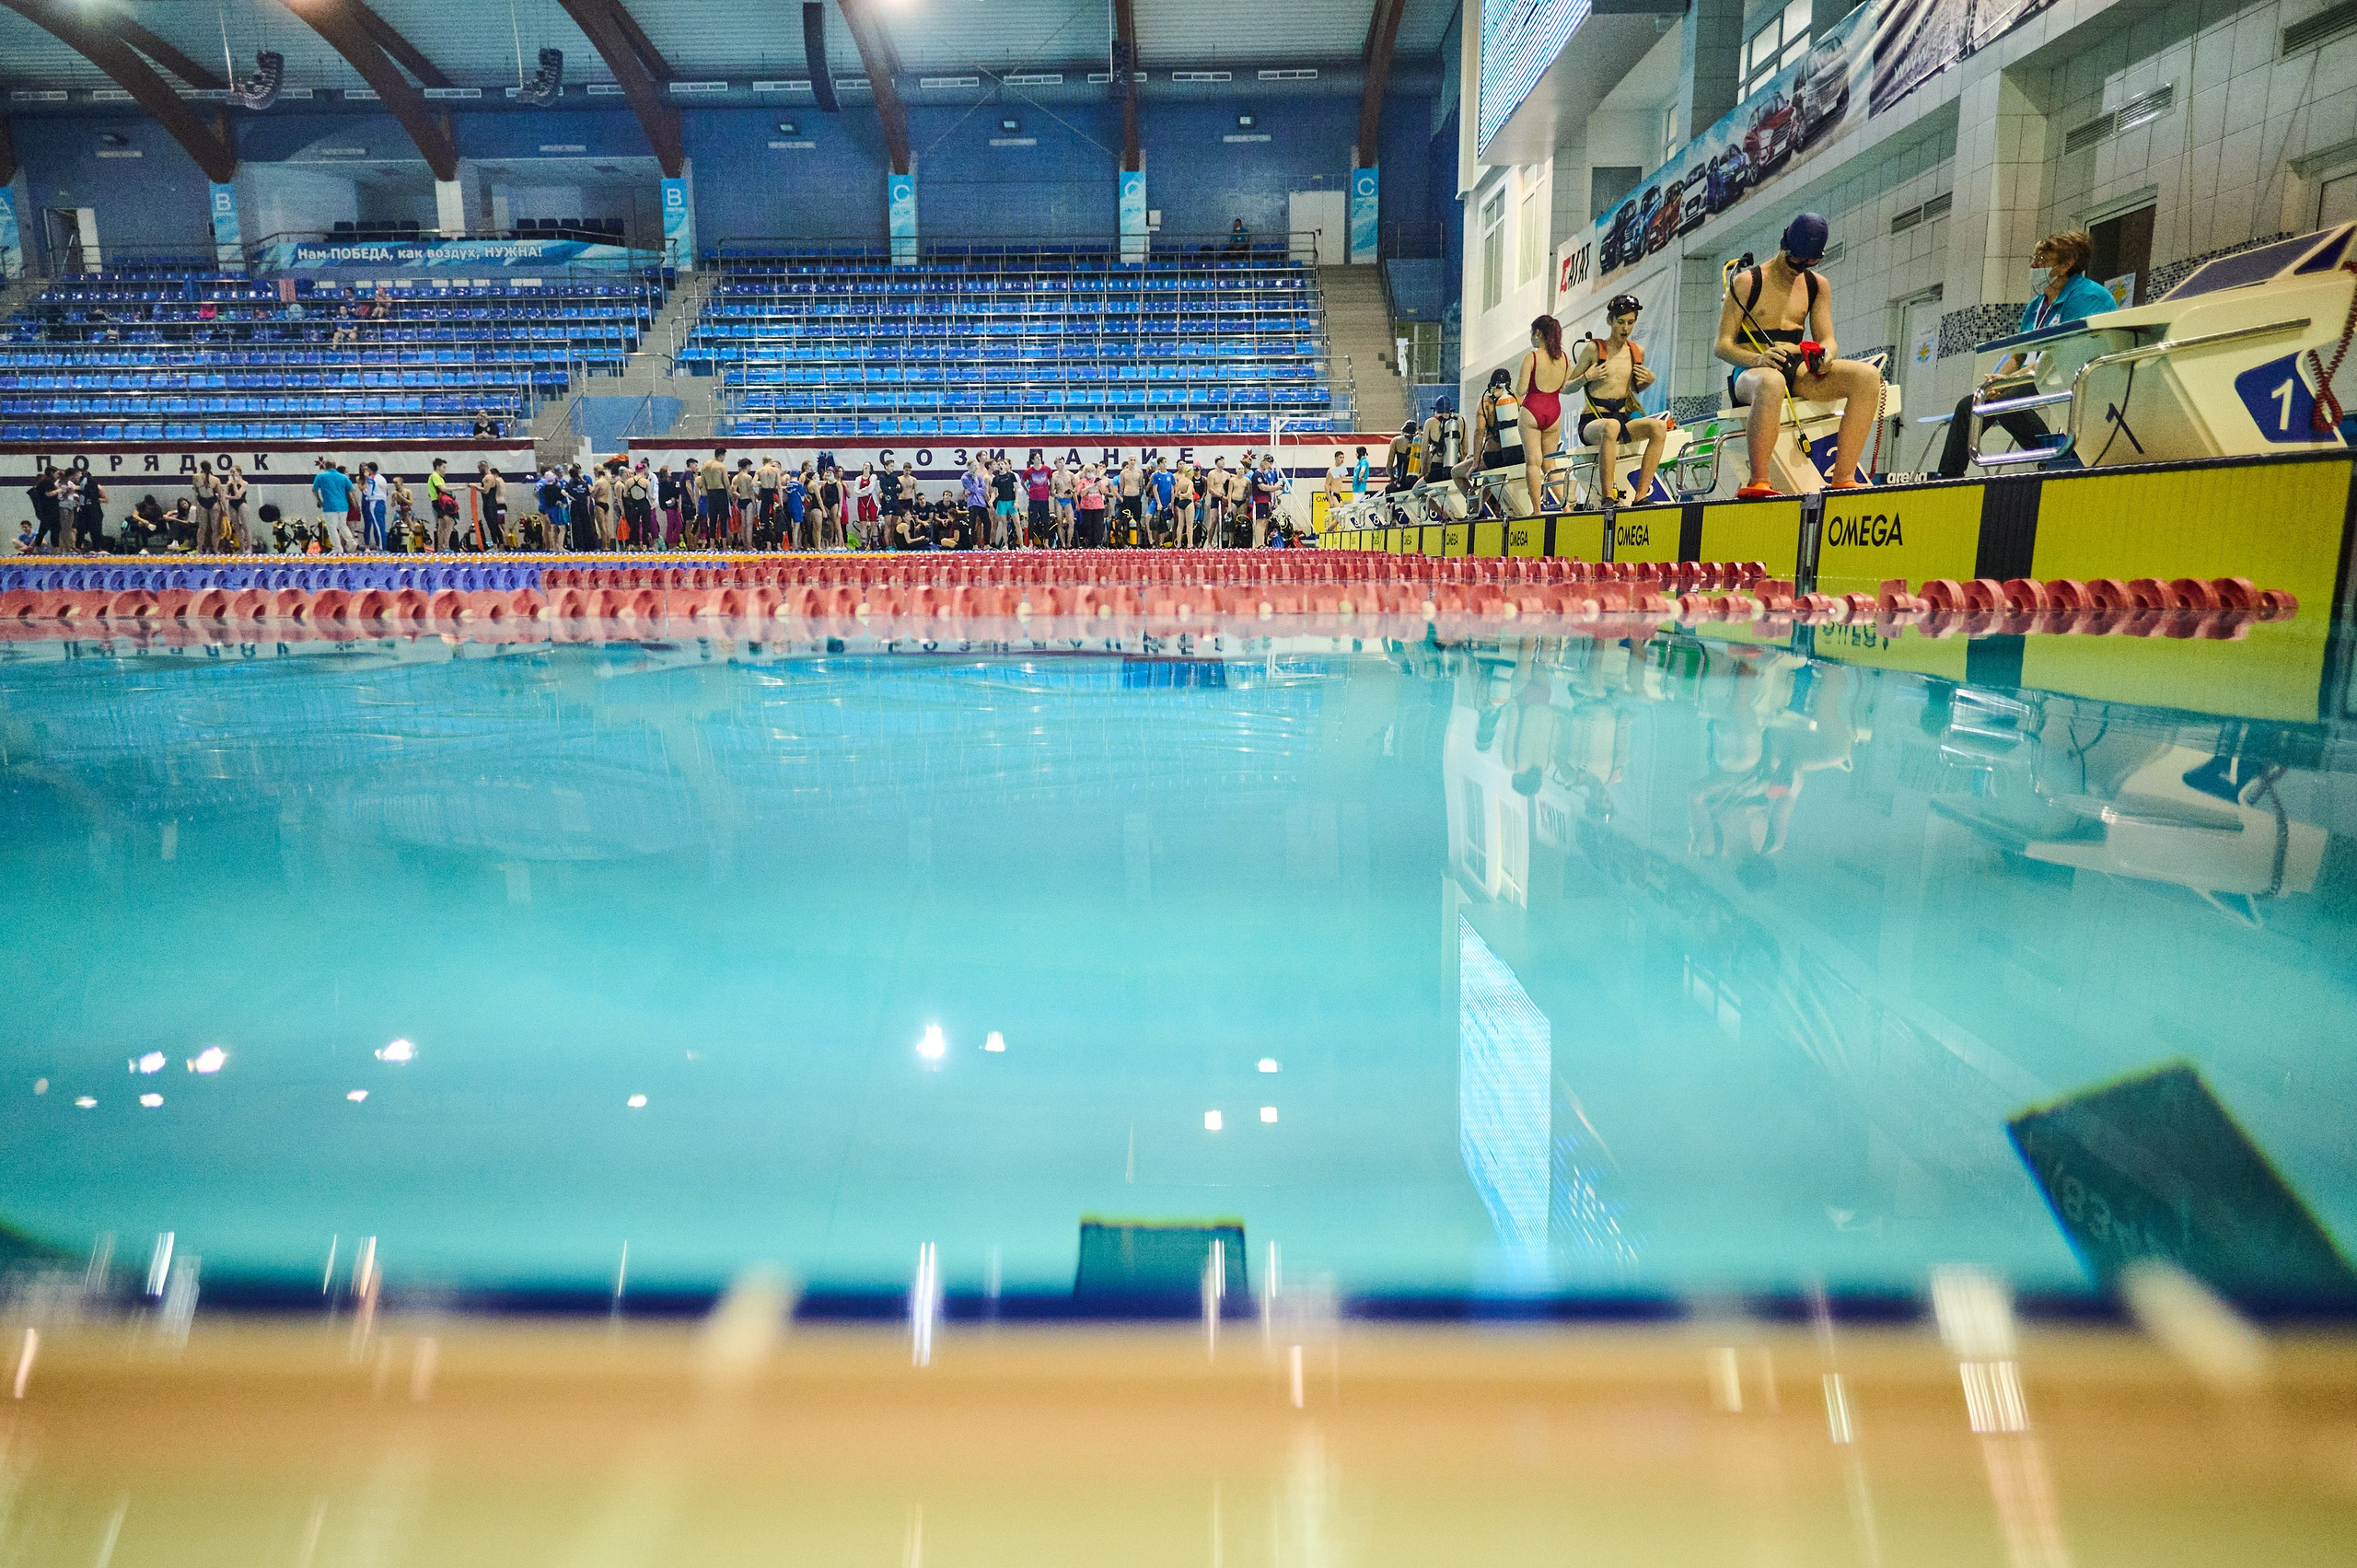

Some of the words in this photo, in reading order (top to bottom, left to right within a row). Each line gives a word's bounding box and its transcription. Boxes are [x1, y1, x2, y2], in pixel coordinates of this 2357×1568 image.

[297, 248, 327, 260] Нам
[331, 248, 394, 261] ПОБЕДА,
[398, 249, 424, 259] как
[427, 249, 479, 261] воздух,
[484, 246, 542, 258] НУЖНА!
[2271, 378, 2293, 431] 1
[36, 454, 270, 474] ПОРЯДОК
[1887, 471, 1928, 484] arena
[1372, 515, 1380, 526] 8
[1398, 511, 1406, 522] 7
[1617, 524, 1650, 546] OMEGA
[1829, 512, 1903, 547] OMEGA
